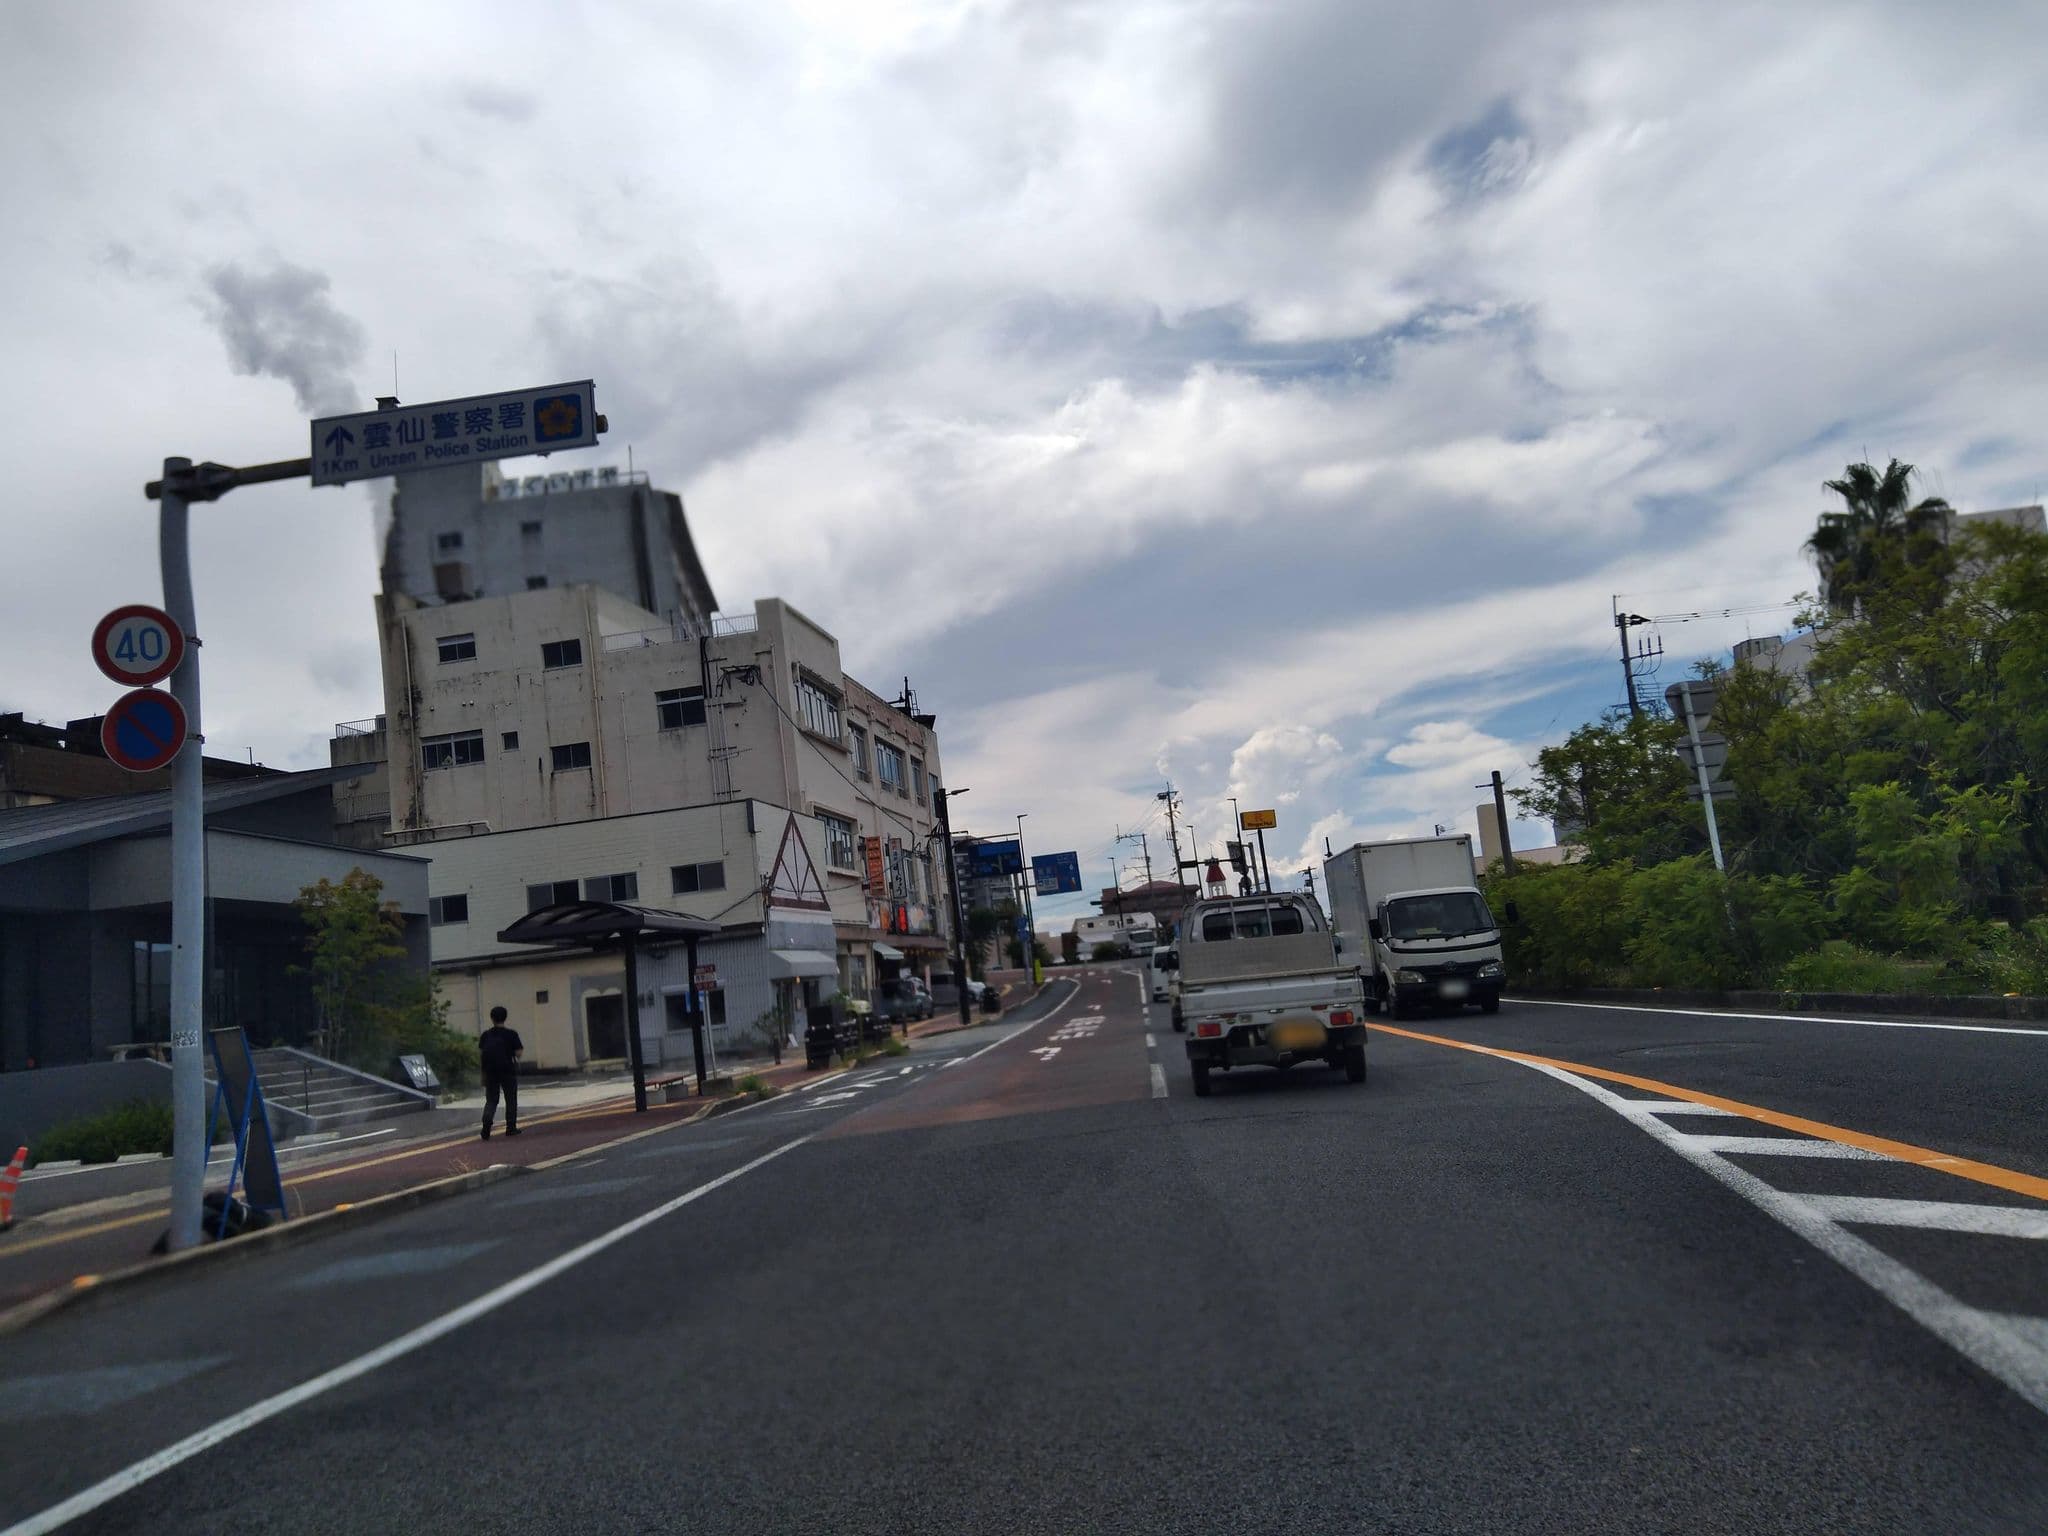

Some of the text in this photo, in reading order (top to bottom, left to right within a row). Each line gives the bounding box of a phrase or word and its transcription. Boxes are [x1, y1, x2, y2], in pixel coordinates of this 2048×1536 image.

[363, 401, 526, 450] 雲仙警察署
[322, 459, 359, 475] 1Km
[370, 433, 528, 470] Unzen Police Station
[115, 626, 164, 663] 40
